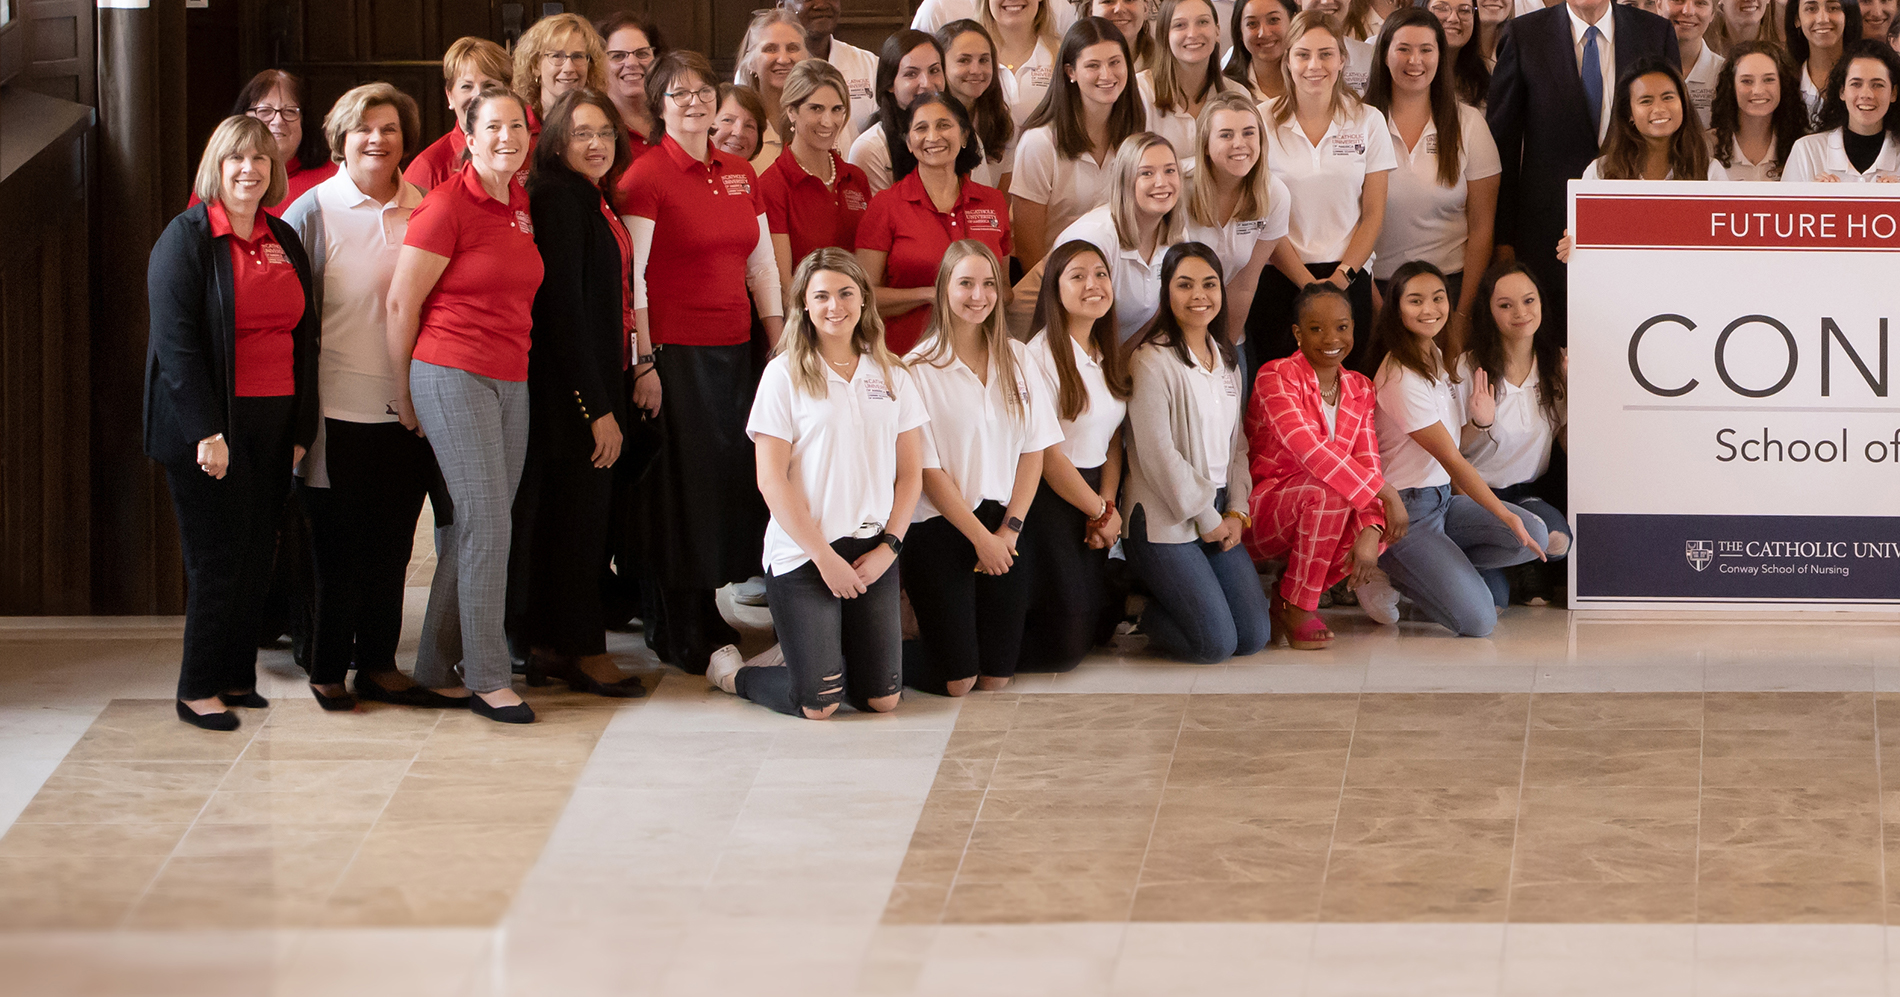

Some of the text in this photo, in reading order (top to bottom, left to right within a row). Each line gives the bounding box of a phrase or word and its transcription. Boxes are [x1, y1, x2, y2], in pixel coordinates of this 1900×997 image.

[1711, 212, 1837, 238] FUTURE
[1715, 427, 1847, 463] School
[1717, 540, 1744, 552] THE
[1745, 541, 1847, 558] CATHOLIC
[1719, 563, 1850, 577] Conway School of Nursing
